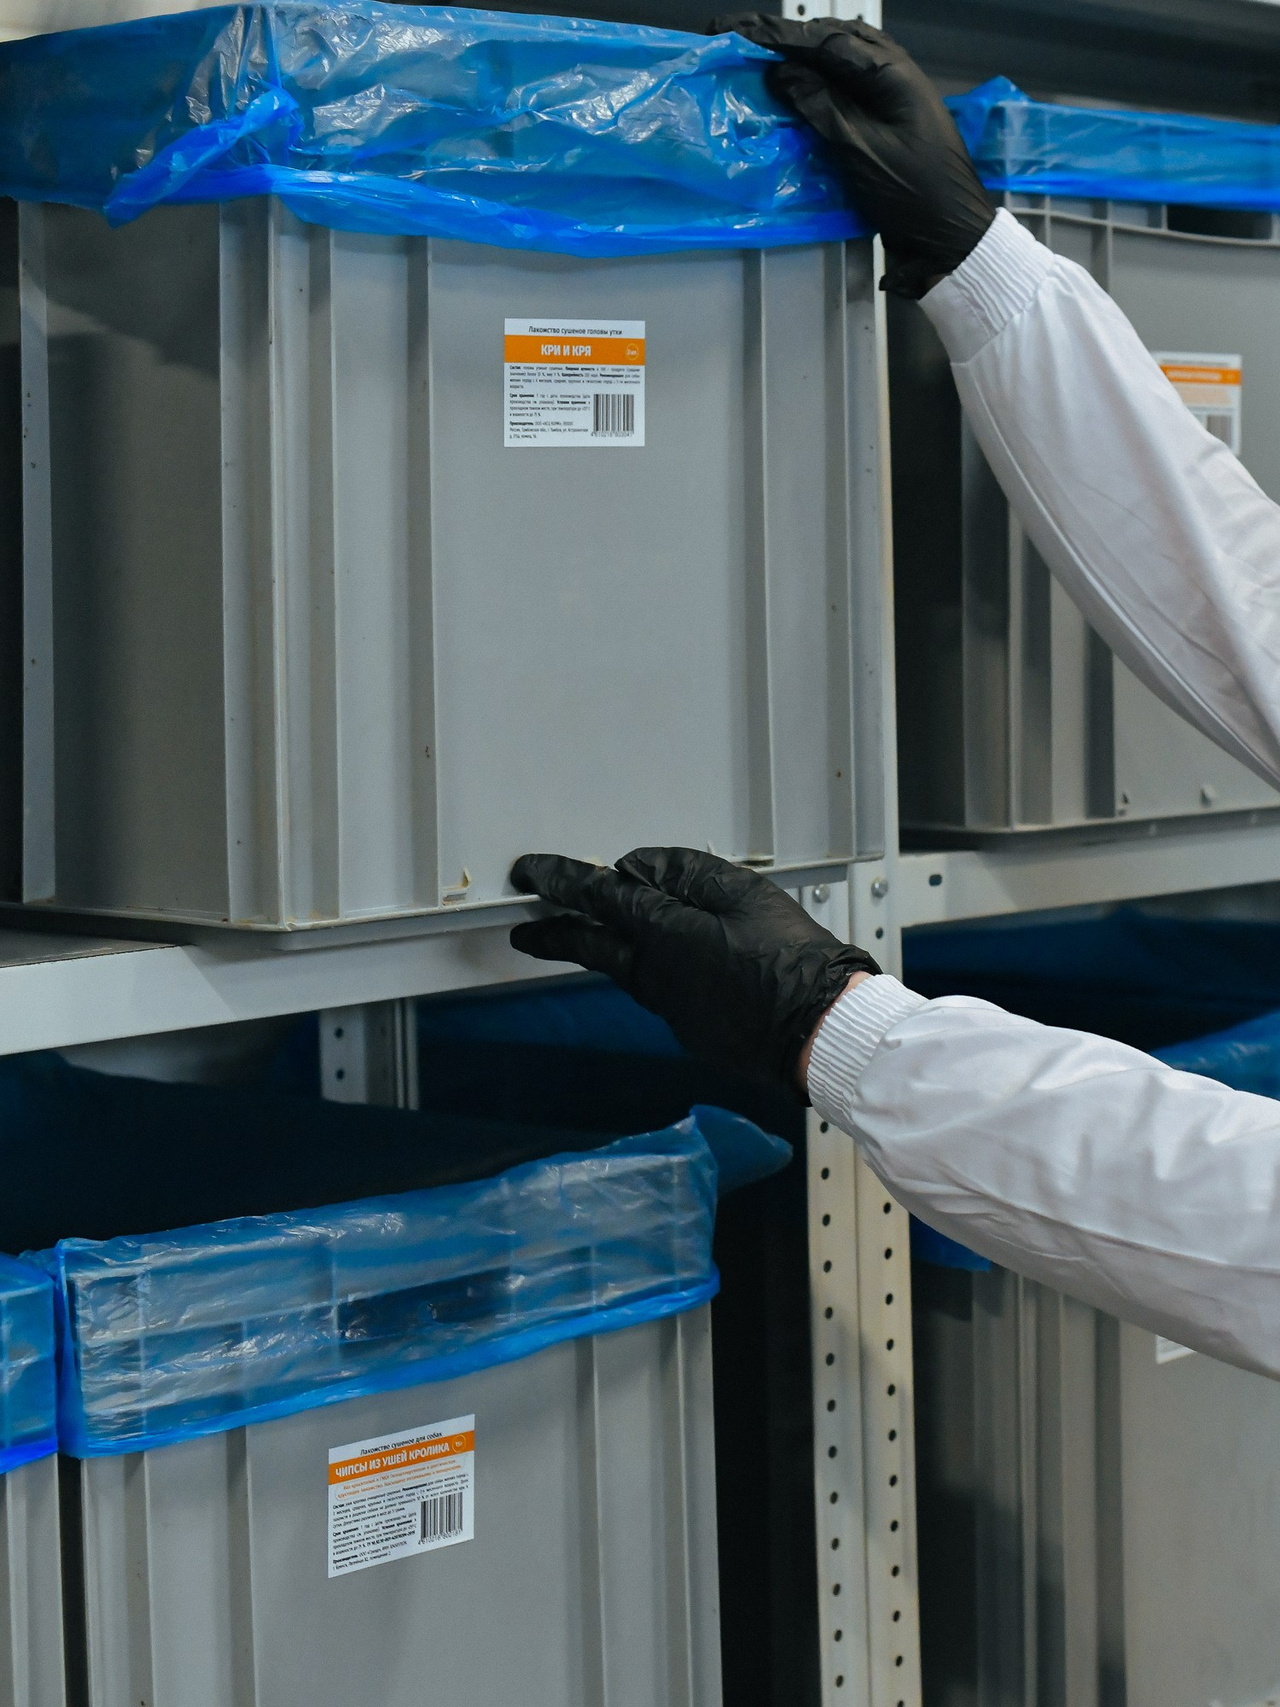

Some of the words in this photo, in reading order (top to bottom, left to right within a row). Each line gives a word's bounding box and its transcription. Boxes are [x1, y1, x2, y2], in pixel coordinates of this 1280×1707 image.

[528, 326, 560, 334] Лакомство
[561, 327, 586, 336] сушеное
[541, 344, 561, 356] КРИ
[563, 345, 570, 356] И
[572, 345, 592, 356] КРЯ
[360, 1444, 390, 1455] Лакомство
[391, 1438, 415, 1450] сушеное
[415, 1436, 426, 1445] для
[427, 1432, 442, 1441] собак
[335, 1461, 367, 1477] ЧИПСЫ
[369, 1458, 381, 1470] ИЗ
[382, 1450, 407, 1467] УШЕЙ
[409, 1442, 450, 1460] КРОЛИКА
